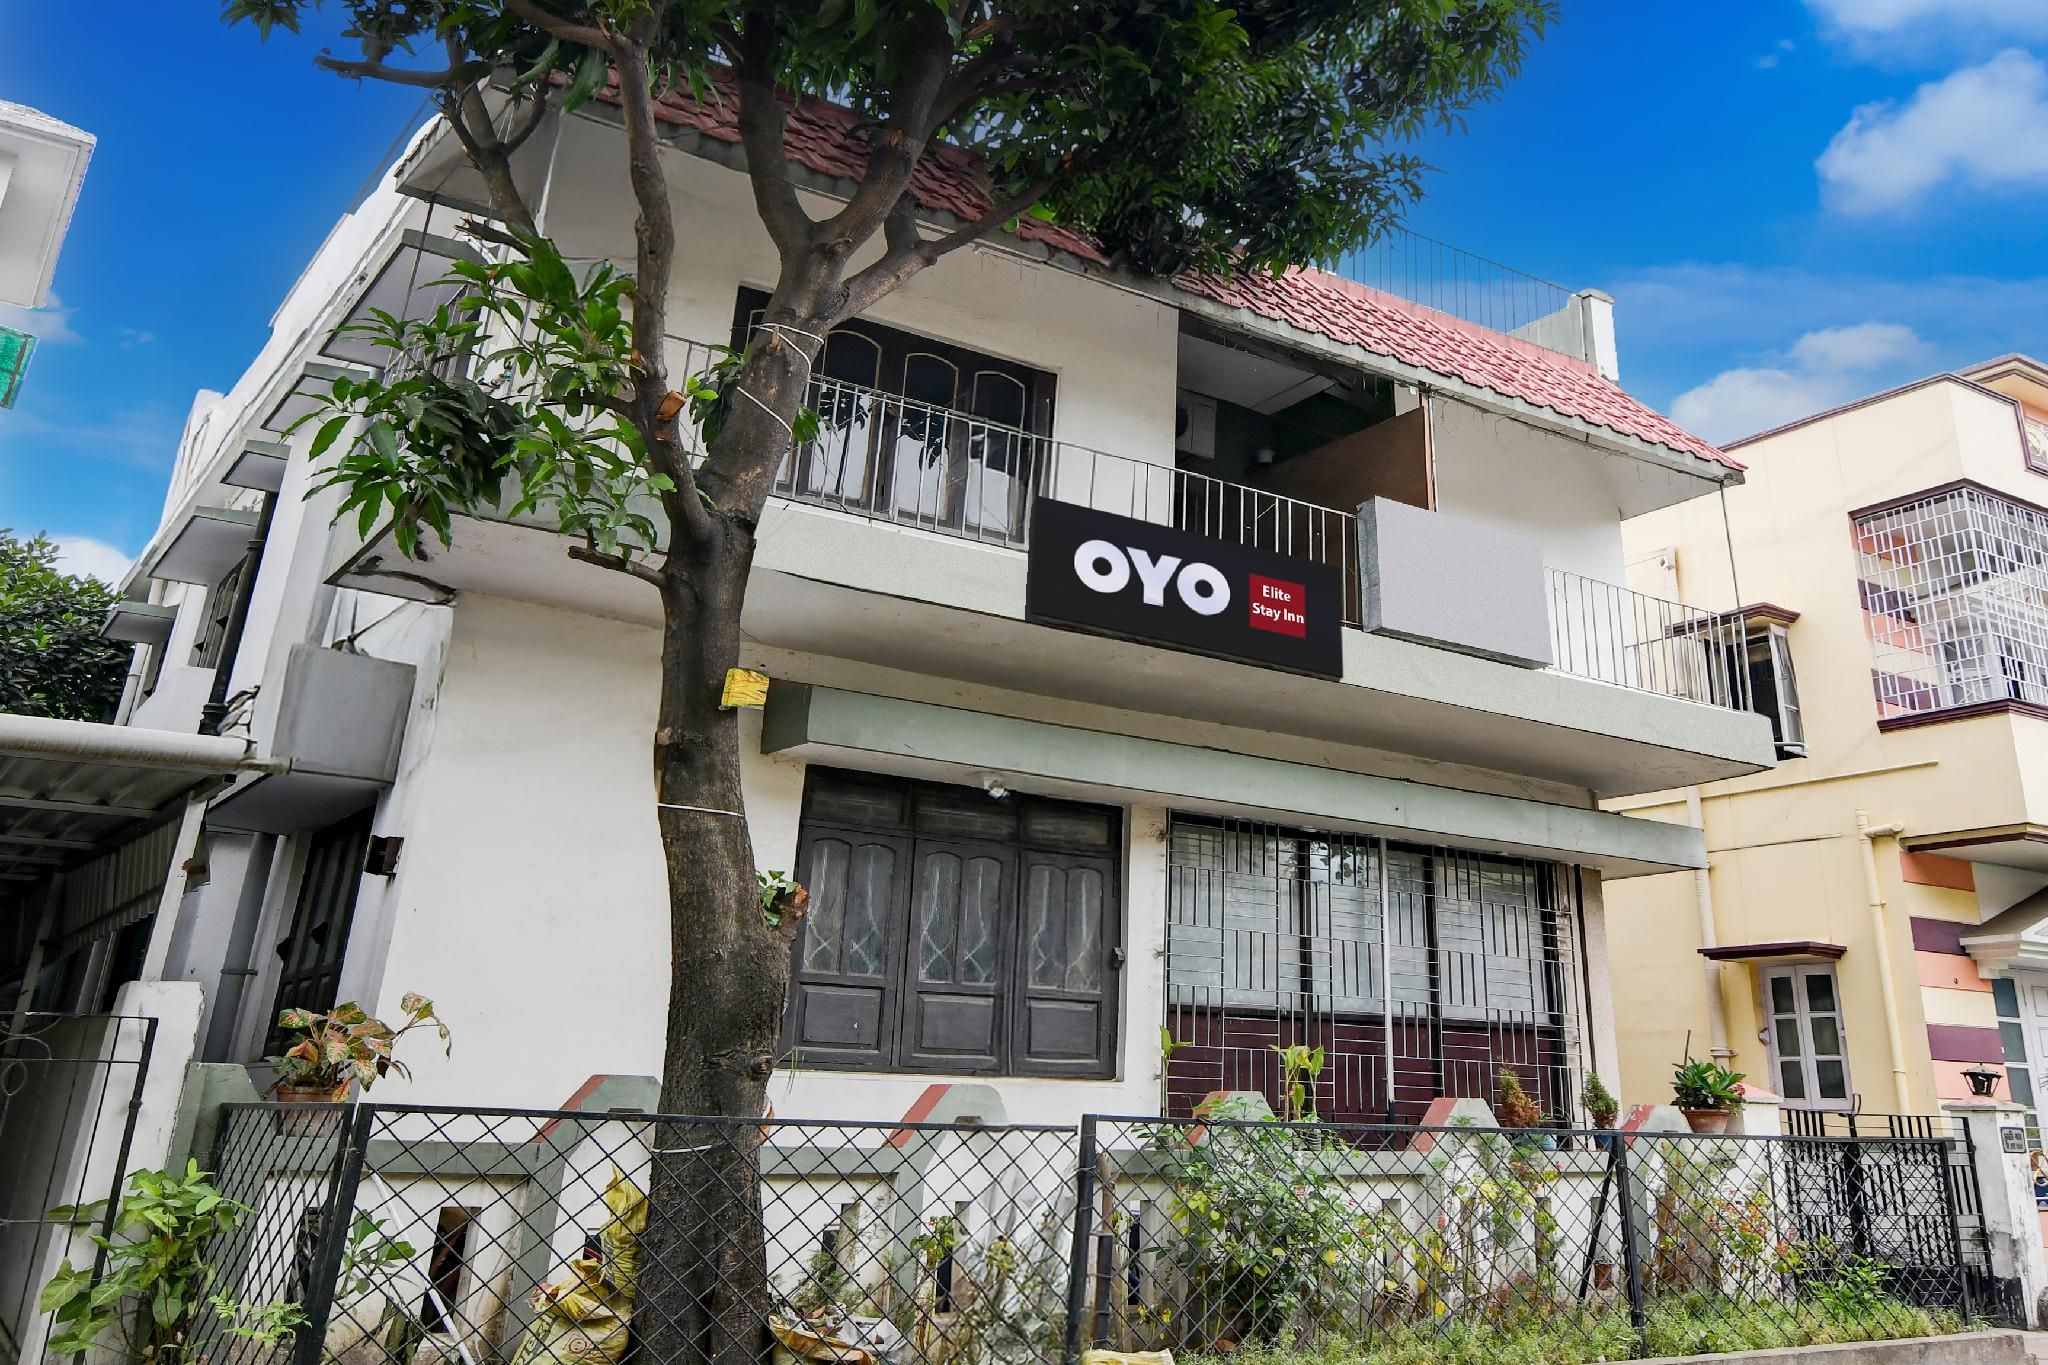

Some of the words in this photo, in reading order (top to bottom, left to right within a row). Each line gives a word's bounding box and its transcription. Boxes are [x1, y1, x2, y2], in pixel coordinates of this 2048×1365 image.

[1074, 539, 1231, 616] OYO
[1262, 584, 1291, 602] Elite
[1252, 602, 1281, 622] Stay
[1283, 608, 1305, 624] Inn
